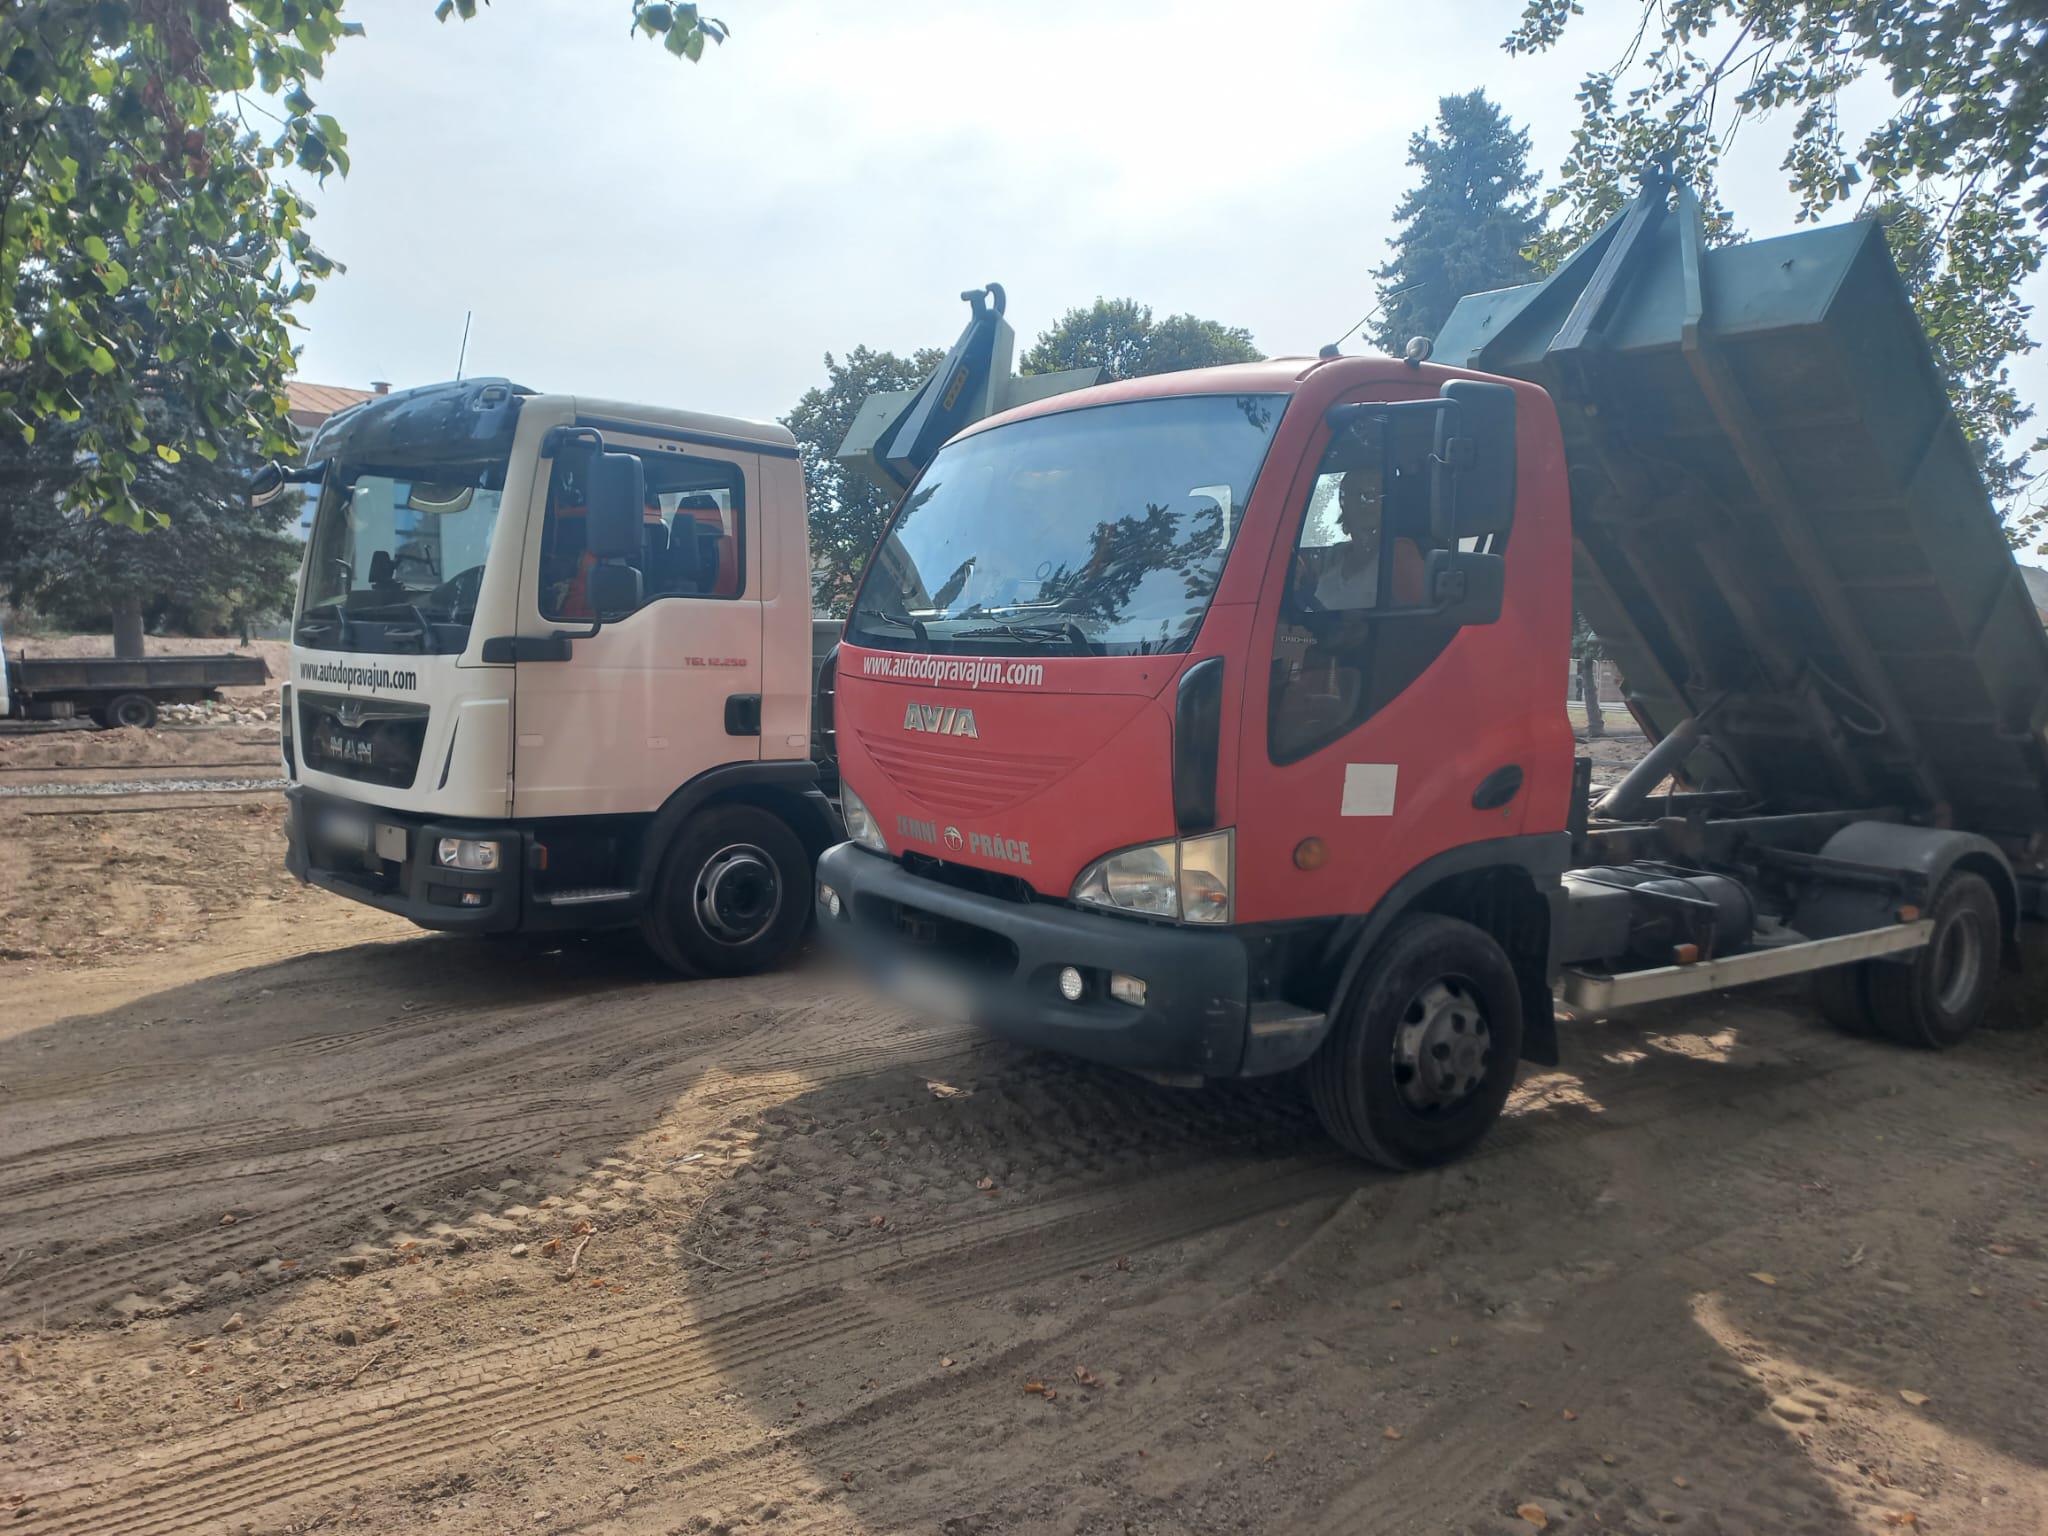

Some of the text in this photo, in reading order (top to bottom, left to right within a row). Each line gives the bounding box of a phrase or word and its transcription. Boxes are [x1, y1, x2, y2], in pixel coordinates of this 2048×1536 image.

[300, 660, 416, 692] www.autodopravajun.com
[863, 655, 1043, 689] www.autodopravajun.com
[904, 703, 979, 739] AVIA
[330, 736, 373, 764] MAN
[968, 832, 1032, 864] PRÁCE
